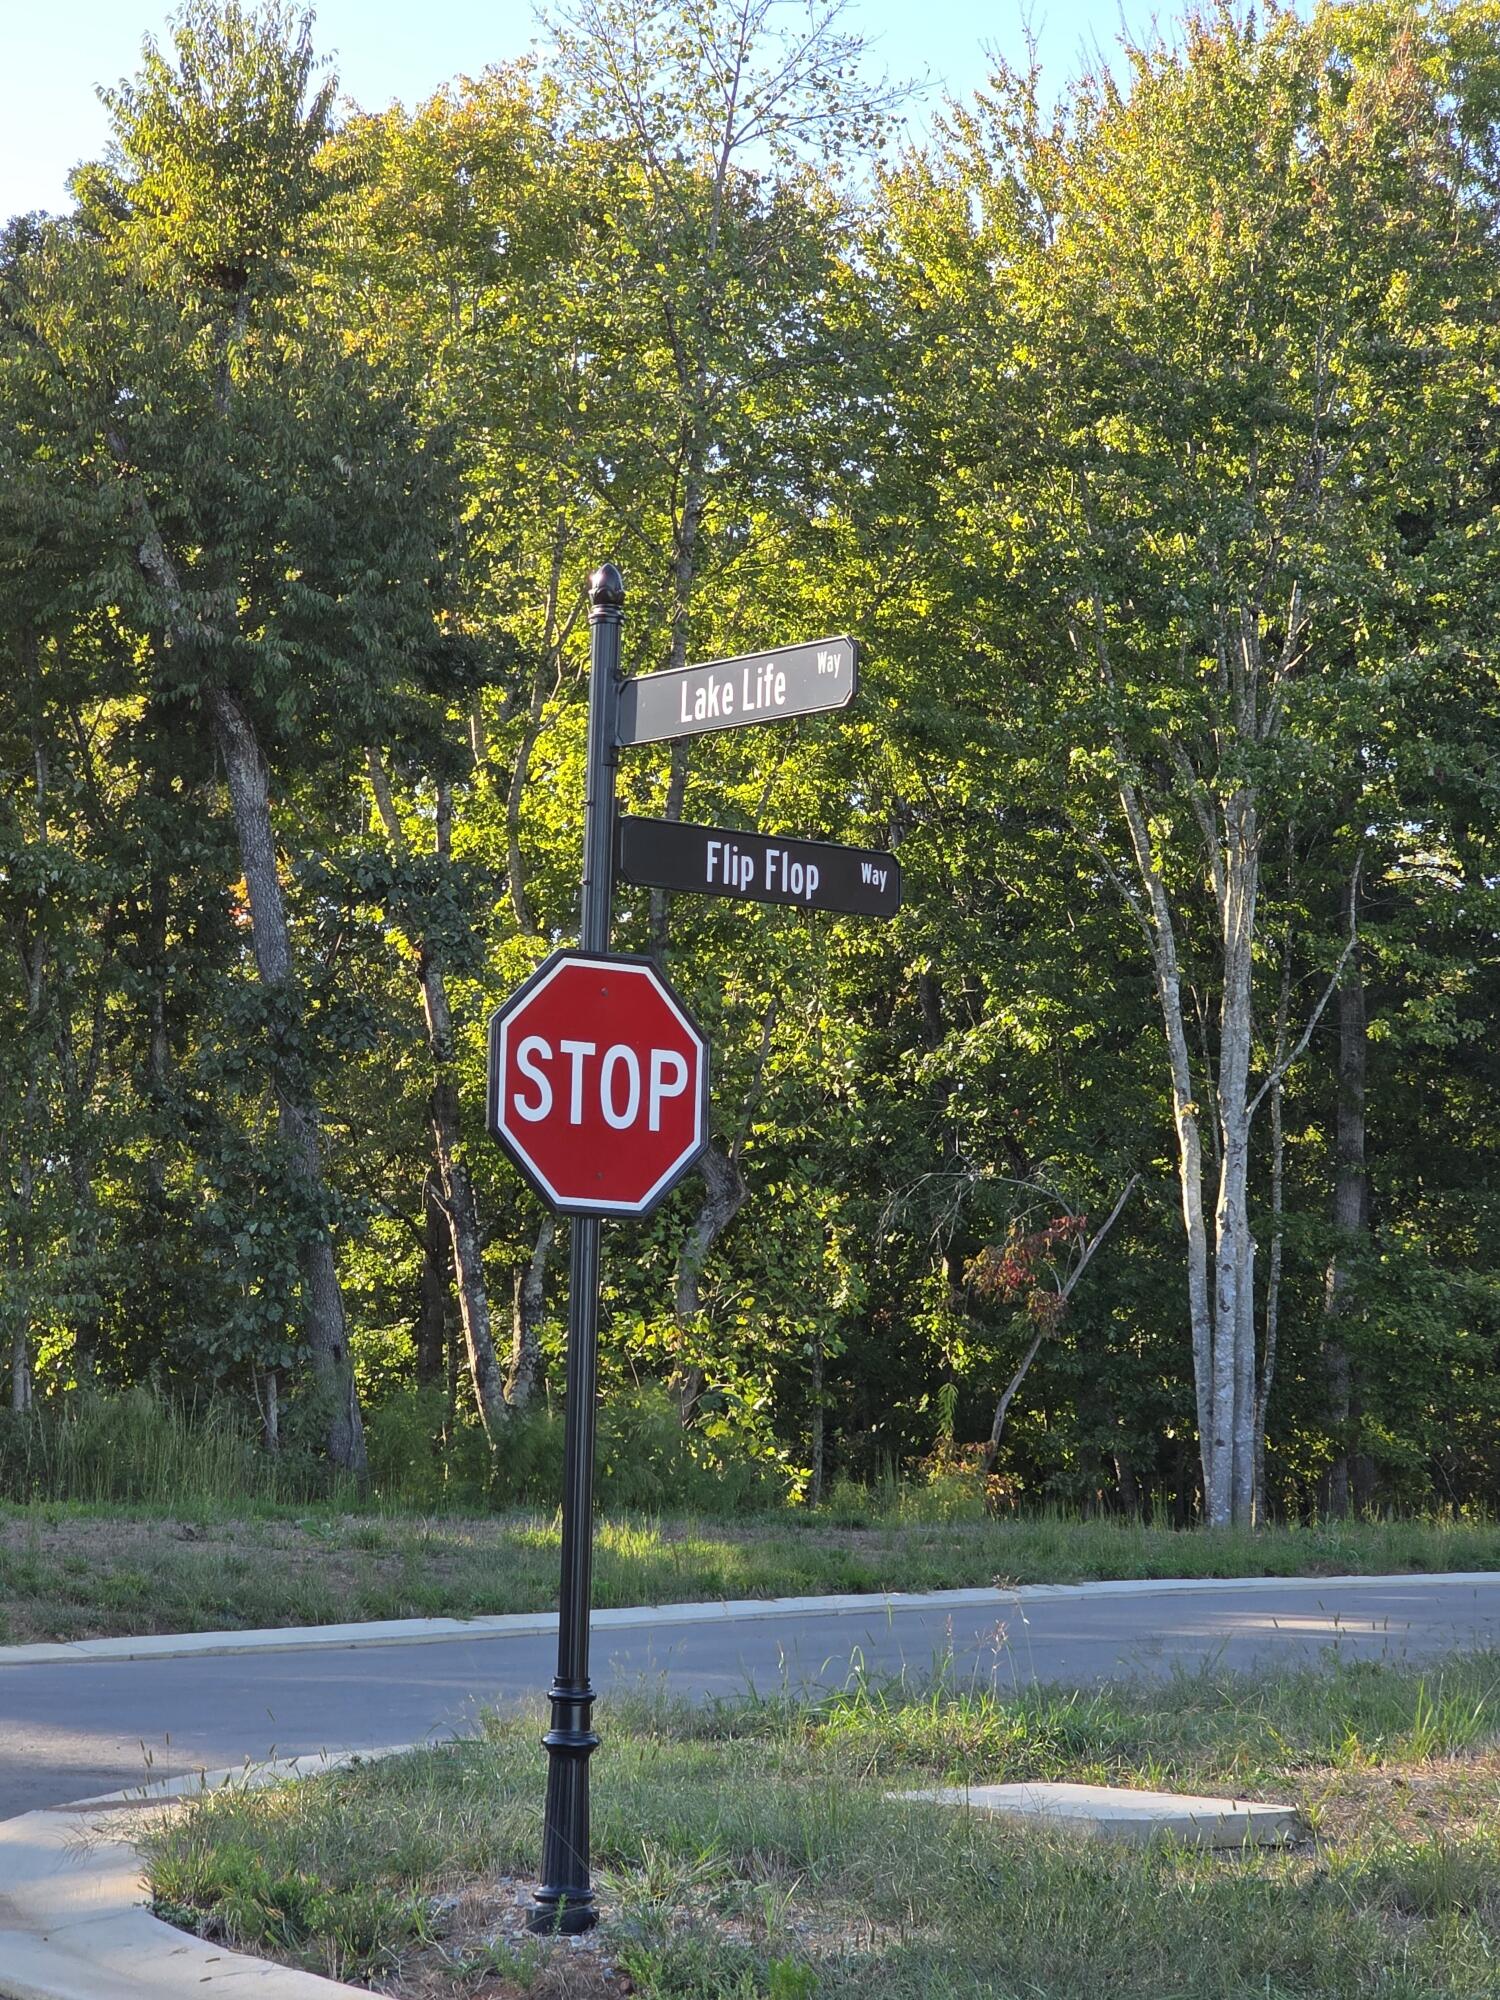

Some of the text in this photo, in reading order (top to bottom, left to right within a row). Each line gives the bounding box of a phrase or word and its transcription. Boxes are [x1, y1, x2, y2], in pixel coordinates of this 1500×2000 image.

[680, 651, 841, 723] Lake Life Way
[706, 840, 887, 900] Flip Flop Way
[513, 1035, 688, 1131] STOP
